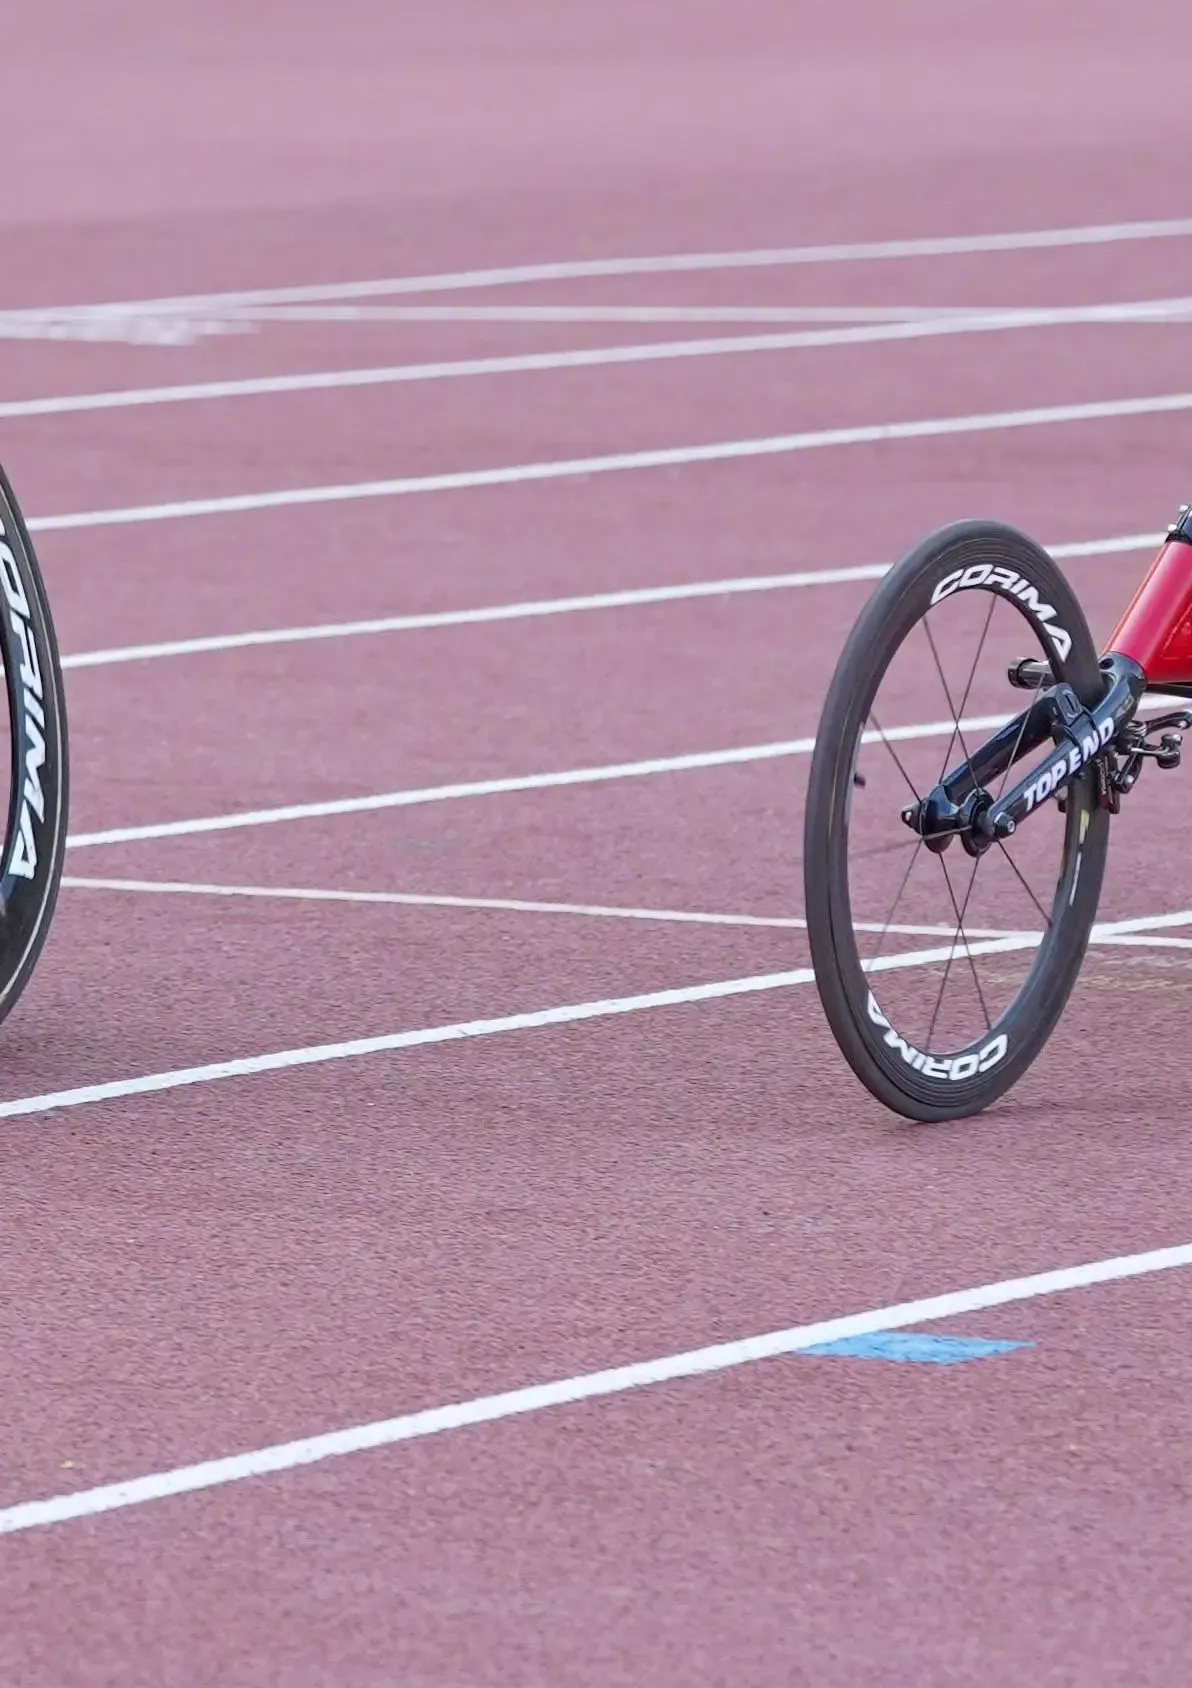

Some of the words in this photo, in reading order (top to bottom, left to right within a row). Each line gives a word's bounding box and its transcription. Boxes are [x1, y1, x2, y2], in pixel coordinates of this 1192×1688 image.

[931, 564, 1072, 662] CORIMA
[0, 515, 46, 879] ORIMA
[867, 989, 1008, 1081] CORIMA
